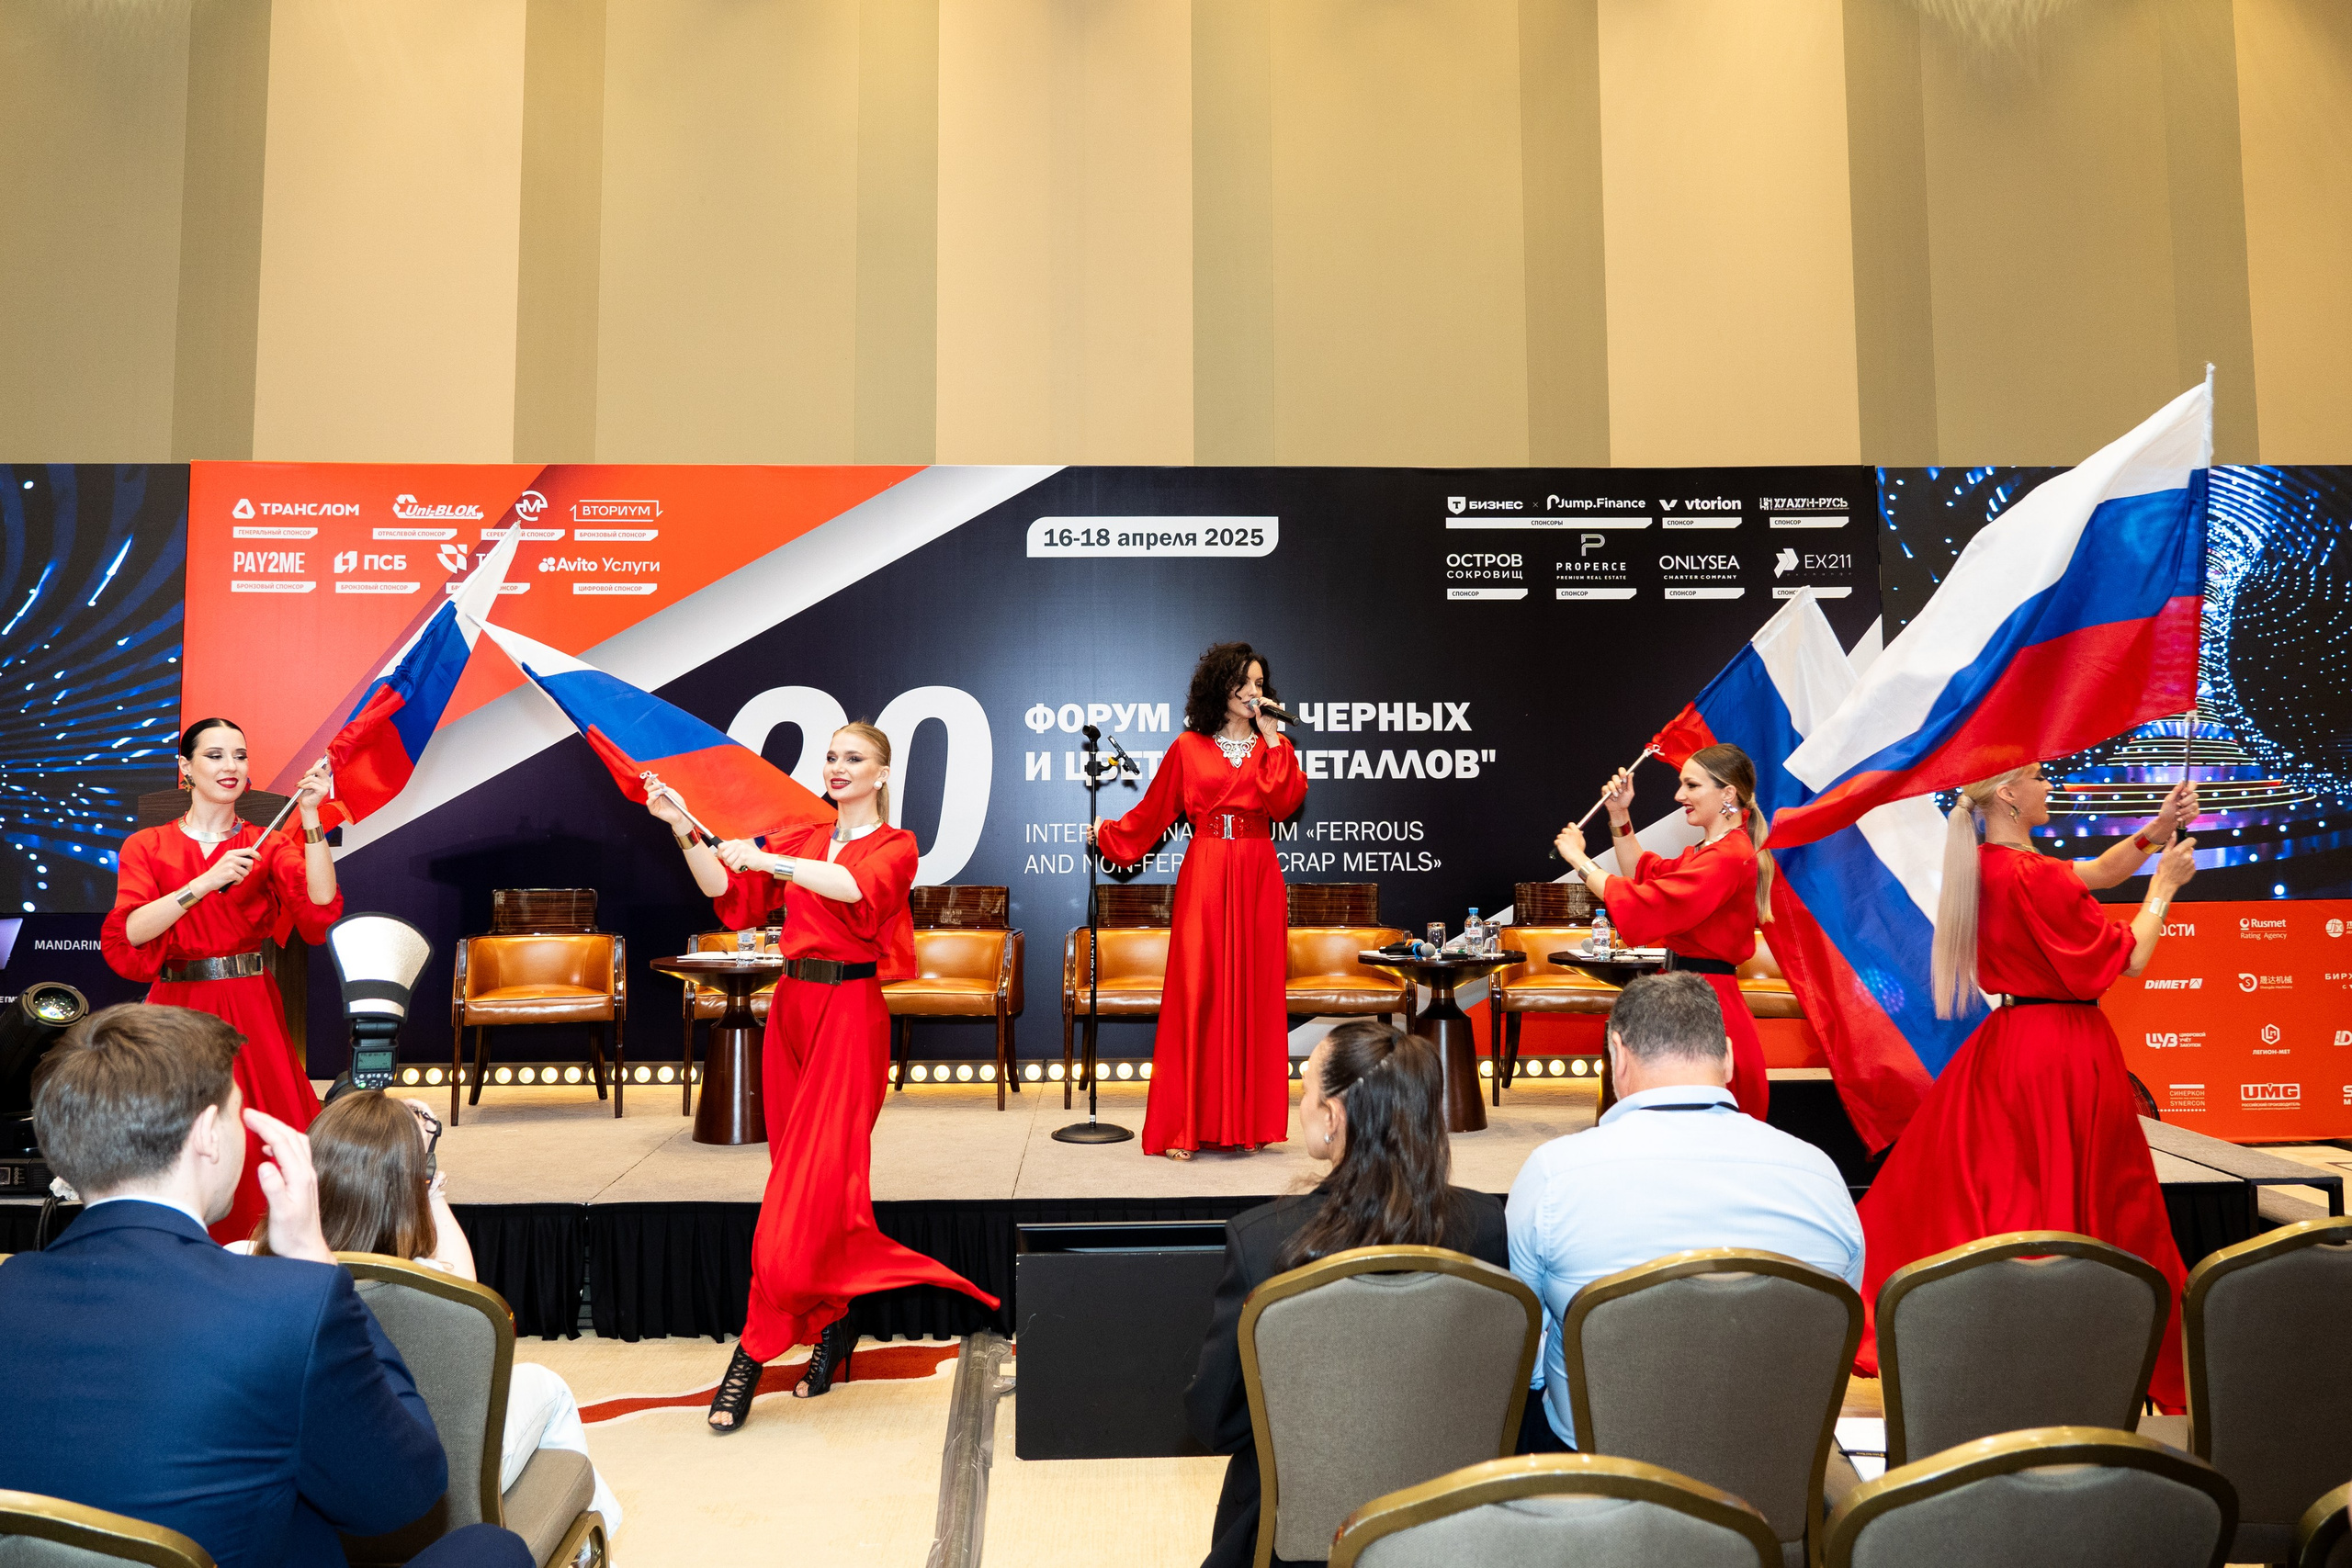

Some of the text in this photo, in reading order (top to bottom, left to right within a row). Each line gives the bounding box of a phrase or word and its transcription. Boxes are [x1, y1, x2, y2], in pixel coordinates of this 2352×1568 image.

[260, 502, 359, 516] ТРАНСЛОМ
[1469, 501, 1523, 510] БИЗНЕС
[1557, 497, 1646, 511] Jump.Finance
[1684, 496, 1742, 511] vtorion
[1773, 497, 1849, 508] ХУАХУН-РУСЬ
[405, 504, 480, 516] Uni-BLOK
[582, 505, 650, 516] ВТОРИУМ
[378, 529, 417, 537] ОТРАСЛЕВОЙ
[580, 530, 617, 538] БРОНЗОВЫЙ
[1044, 527, 1264, 550] 16-18 апреля 2025
[233, 551, 305, 573] PAY2ME
[363, 554, 408, 570] ПСБ
[556, 557, 661, 575] Avito Услуги
[1446, 553, 1523, 568] ОСТРОВ
[1555, 561, 1627, 571] PROPERCE
[1658, 554, 1741, 570] ONLYSEA
[1804, 553, 1851, 569] EX211
[1446, 570, 1523, 581] СОКРОВИЩ
[578, 584, 614, 592] ЦИФРОВОЙ
[1024, 702, 1170, 734] ФОРУМ
[1298, 702, 1473, 732] ЧЕРНЫХ
[1025, 750, 1051, 781] И
[1306, 820, 1424, 841] «FERROUS
[1023, 854, 1074, 874] AND
[1276, 852, 1336, 872] CRAP
[1343, 852, 1442, 872] METALS»
[2250, 918, 2287, 928] Rusmet
[2240, 932, 2287, 941] Rating Agency
[2145, 1032, 2178, 1049] ЦУЗ
[2243, 1085, 2299, 1099] UMG
